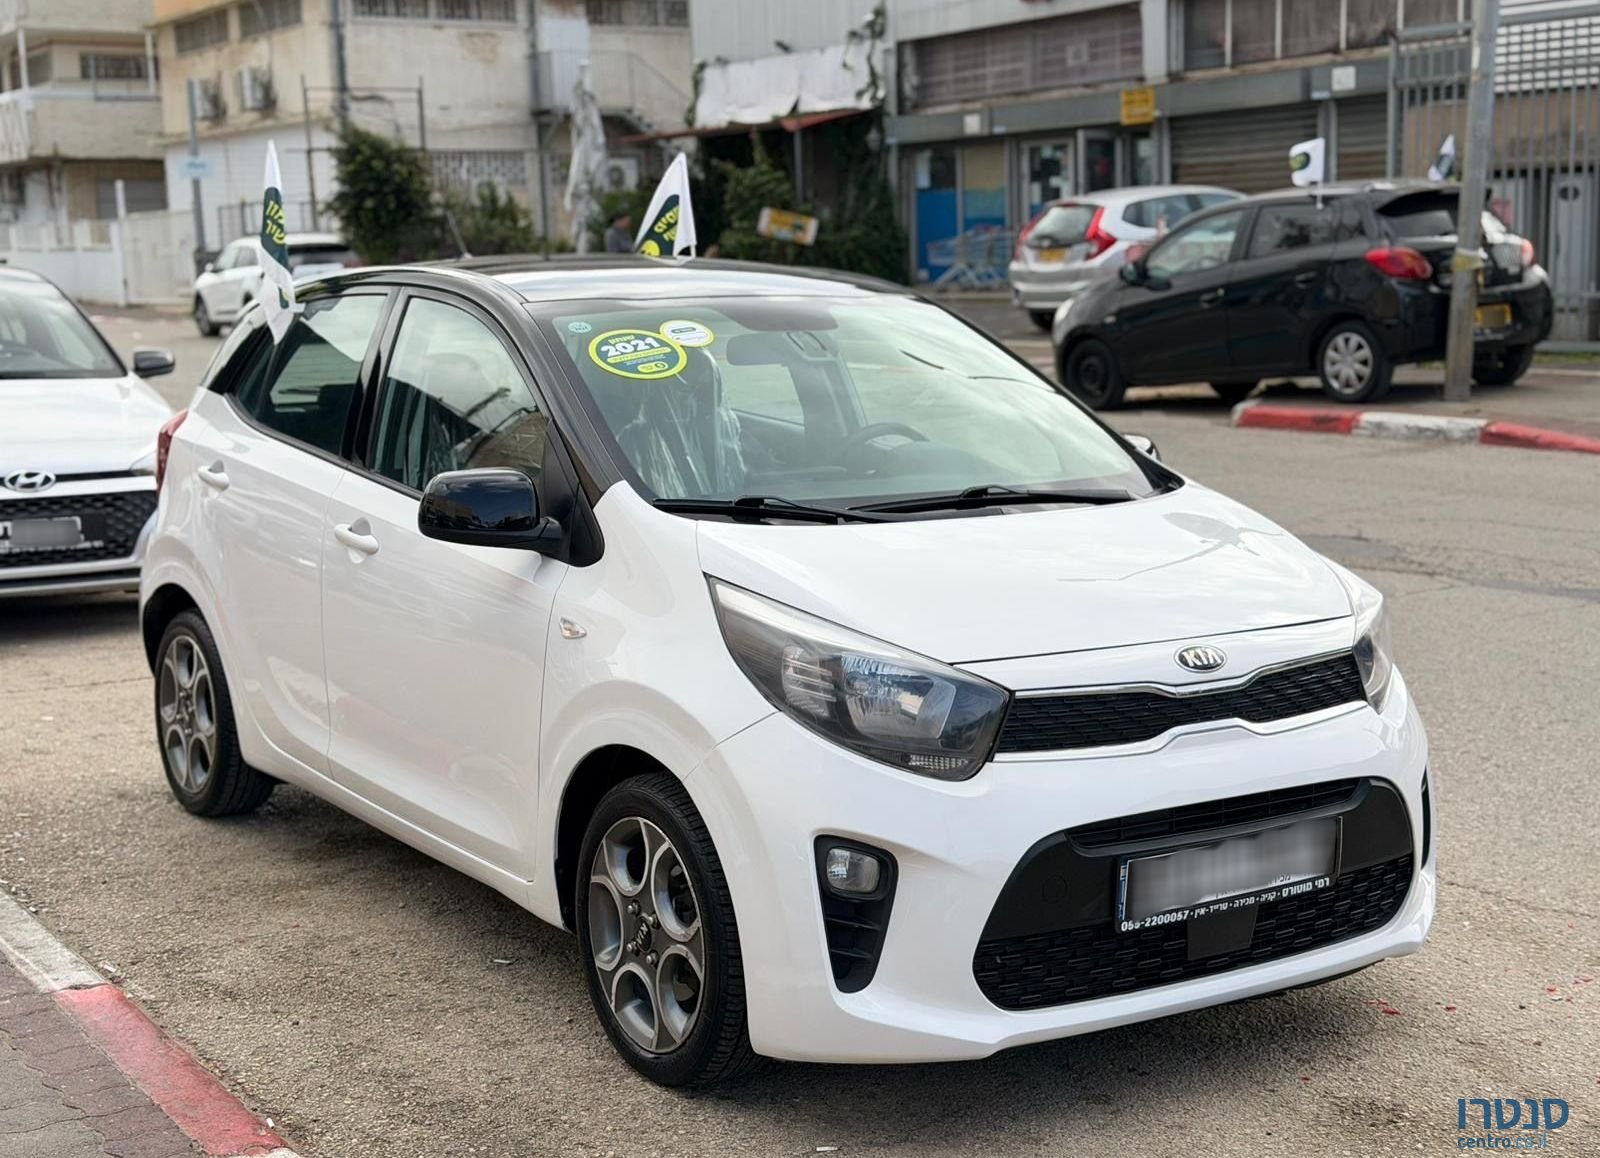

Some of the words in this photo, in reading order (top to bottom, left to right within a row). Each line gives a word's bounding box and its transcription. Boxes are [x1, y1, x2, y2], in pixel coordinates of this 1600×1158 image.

[600, 337, 660, 358] 2021
[1182, 648, 1222, 667] KIA
[1282, 881, 1313, 898] מוטורס
[1315, 877, 1330, 888] רמי
[1233, 896, 1255, 908] מכירה
[635, 922, 649, 945] KIA
